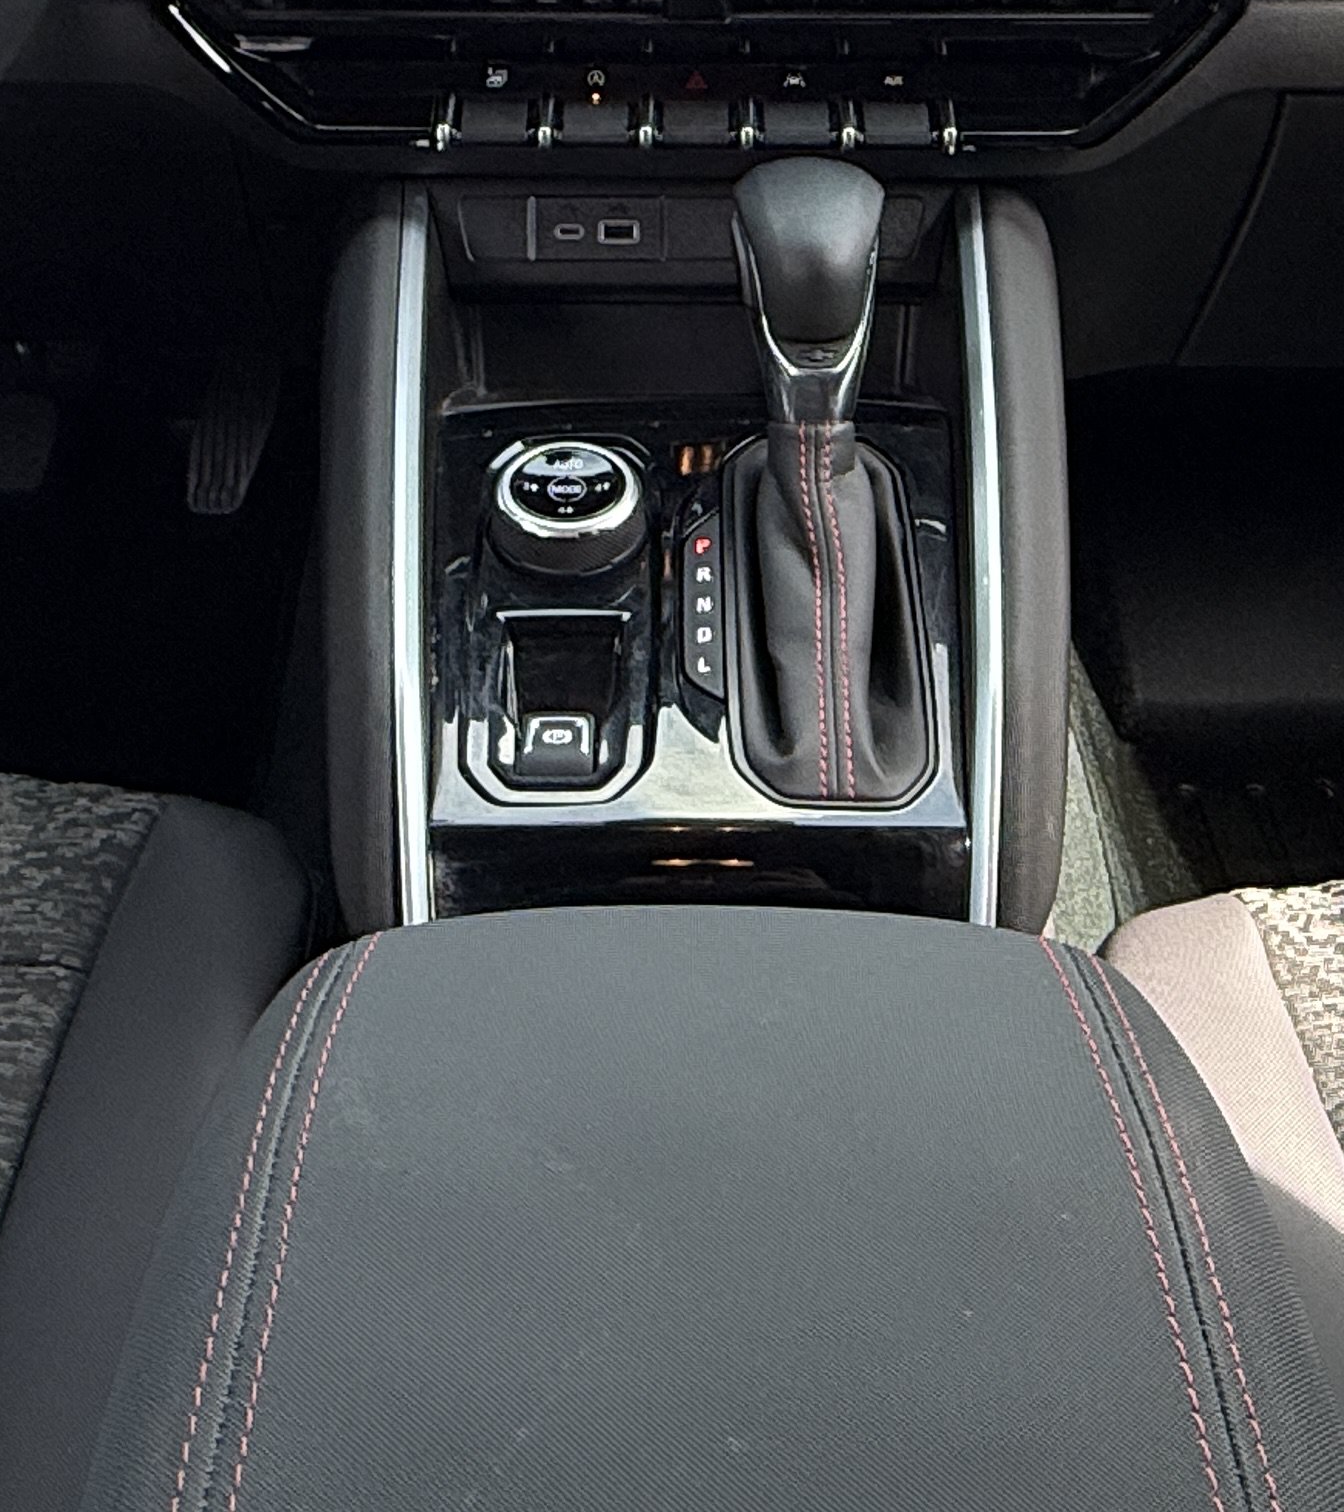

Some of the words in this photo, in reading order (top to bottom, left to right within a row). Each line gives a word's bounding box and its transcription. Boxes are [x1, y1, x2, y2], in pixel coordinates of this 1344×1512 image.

[695, 538, 712, 555] P
[696, 566, 713, 582] R
[696, 597, 714, 614] N
[697, 627, 714, 644] D
[697, 657, 712, 674] L
